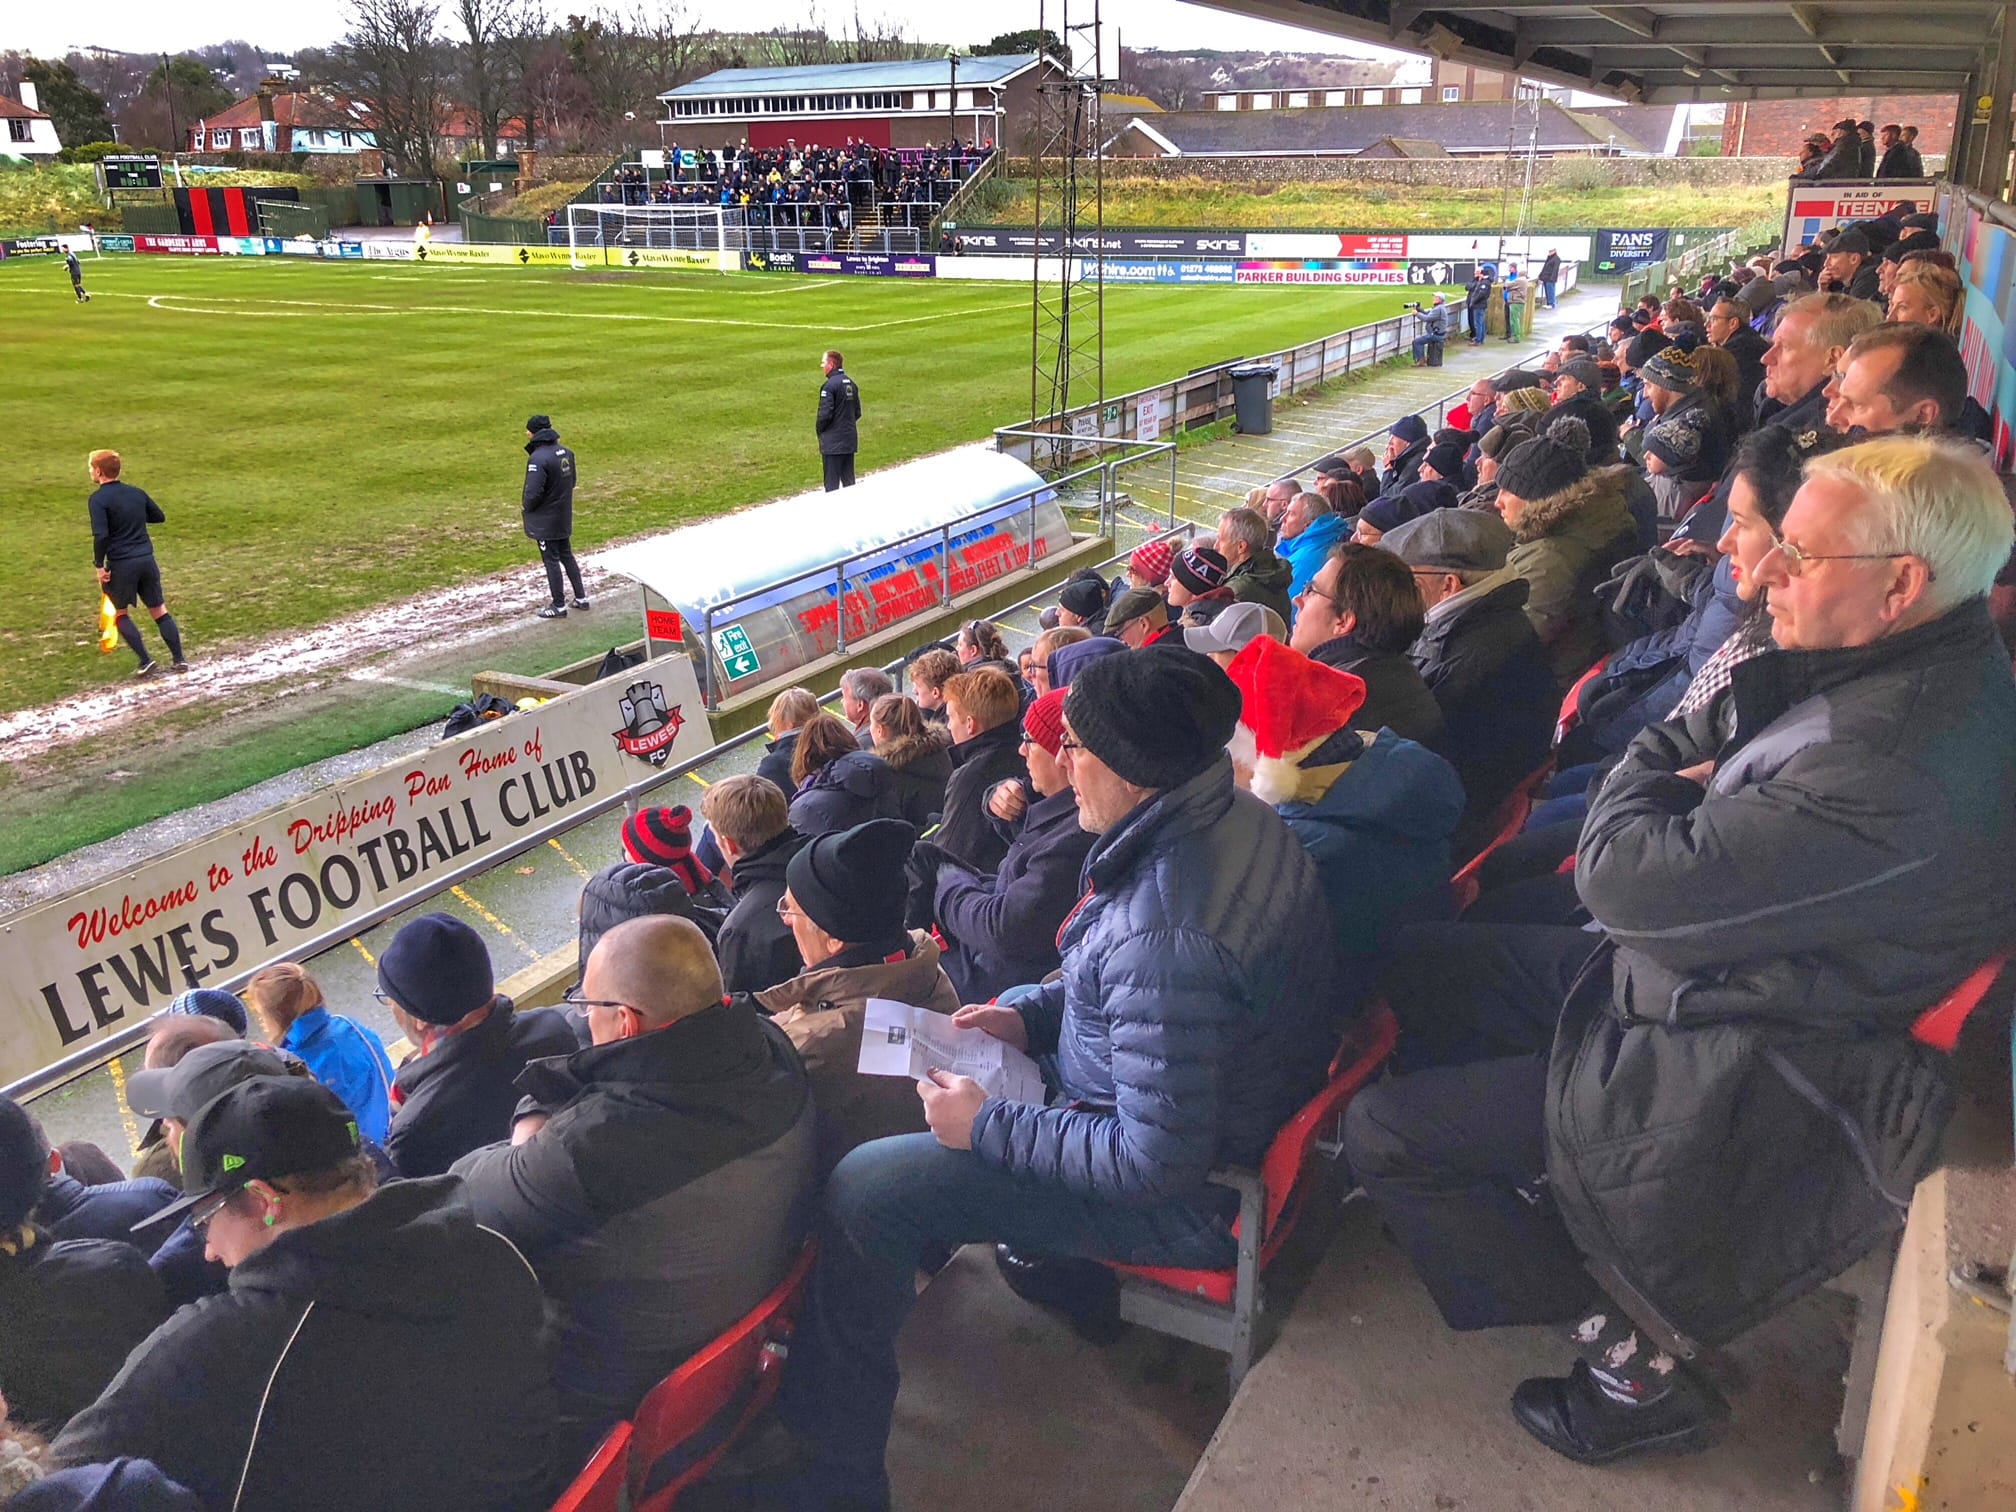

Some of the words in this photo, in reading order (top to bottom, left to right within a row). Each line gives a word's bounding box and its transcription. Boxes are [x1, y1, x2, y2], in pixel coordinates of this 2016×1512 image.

[1840, 201, 1930, 216] TEENE
[1611, 233, 1653, 246] FANS
[769, 252, 794, 262] Bostik
[1237, 272, 1283, 282] PARKER
[1286, 273, 1341, 282] BUILDING
[1344, 273, 1404, 283] SUPPLIES
[1143, 404, 1153, 416] EXIT
[651, 615, 675, 625] HOME
[653, 627, 676, 635] TEAM
[728, 628, 743, 641] Fire
[734, 641, 748, 653] exit
[630, 722, 676, 751] LEWES
[649, 749, 666, 763] FC
[67, 881, 198, 949] Welcome
[207, 863, 233, 892] to
[242, 836, 279, 878] the
[288, 795, 396, 855] Dripping
[404, 770, 452, 806] Pan
[459, 744, 517, 781] Home
[525, 726, 543, 763] of
[40, 908, 240, 1047] LEWES
[248, 798, 491, 947] FOOTBALL
[499, 750, 596, 827] CLUB
